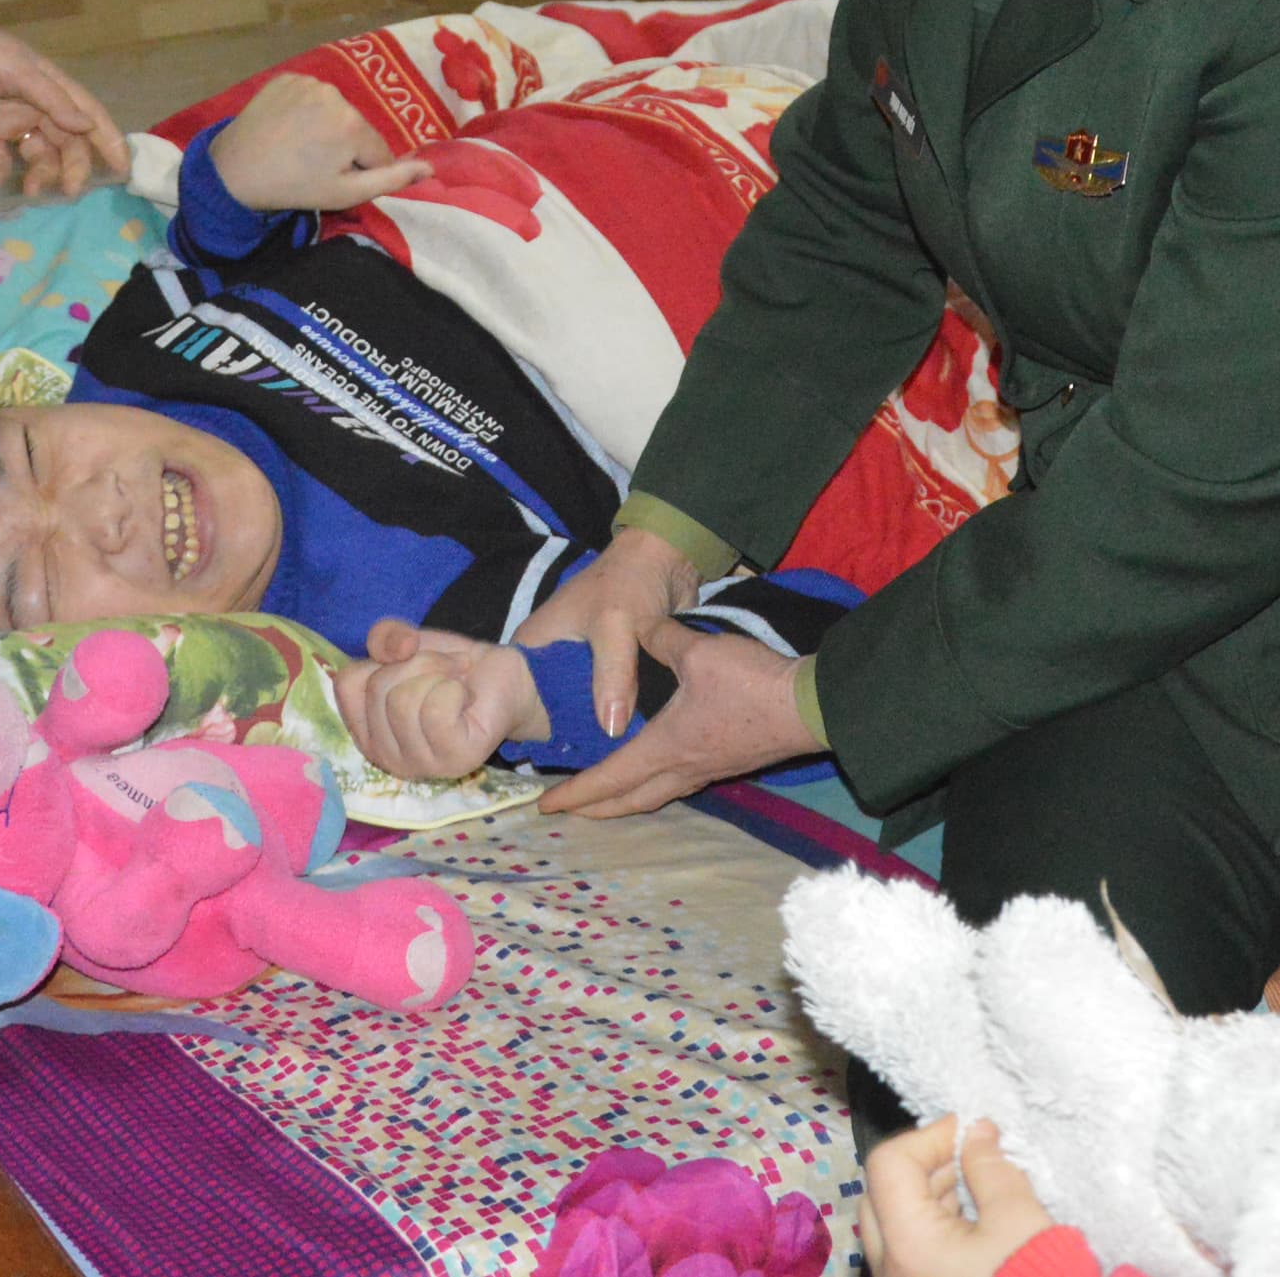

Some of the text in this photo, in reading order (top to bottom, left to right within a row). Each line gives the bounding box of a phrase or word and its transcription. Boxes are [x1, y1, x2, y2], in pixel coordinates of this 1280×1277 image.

[300, 302, 399, 376] PRODUCT
[292, 343, 357, 395] OCEANS
[357, 391, 391, 420] THE
[391, 416, 416, 437] TO
[397, 370, 498, 443] PREMIUM
[415, 432, 472, 472] DOWN
